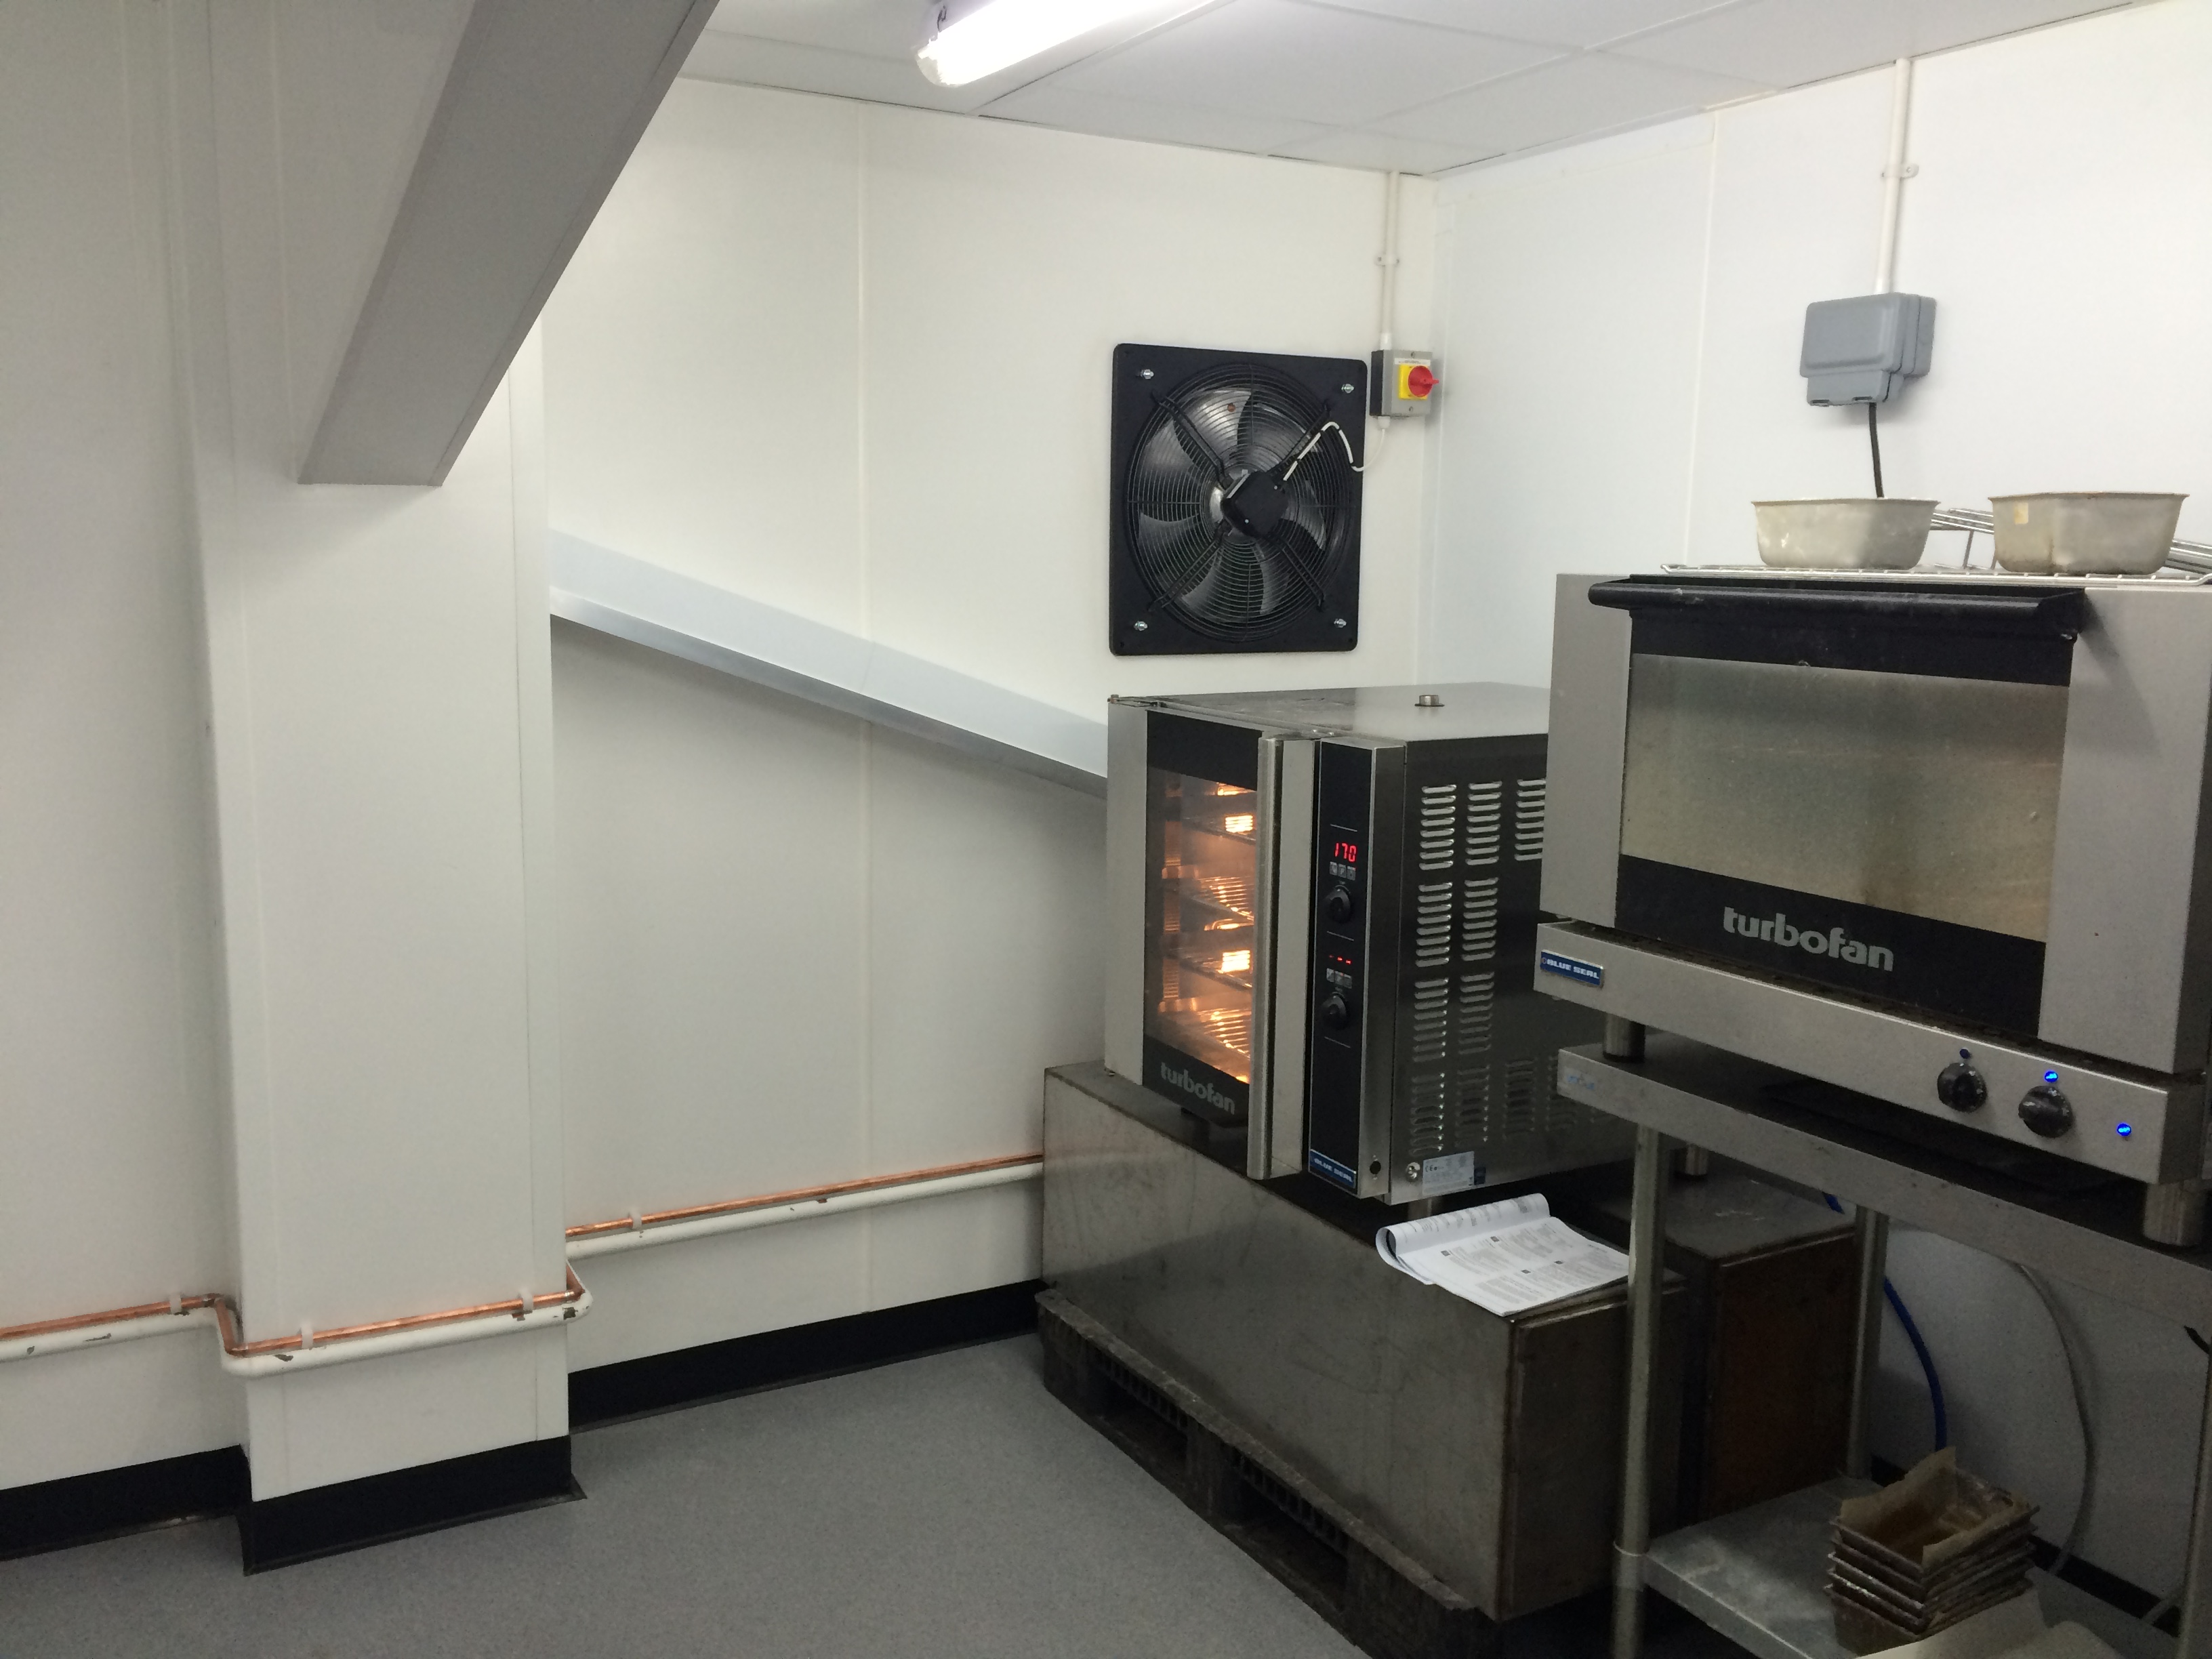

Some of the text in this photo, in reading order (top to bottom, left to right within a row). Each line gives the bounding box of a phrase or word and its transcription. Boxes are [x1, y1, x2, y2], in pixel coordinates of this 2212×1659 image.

[1334, 842, 1357, 862] 170
[1723, 906, 1894, 972] turbofan
[1547, 958, 1600, 980] BLUE SEAL
[1160, 1061, 1235, 1115] turbofan
